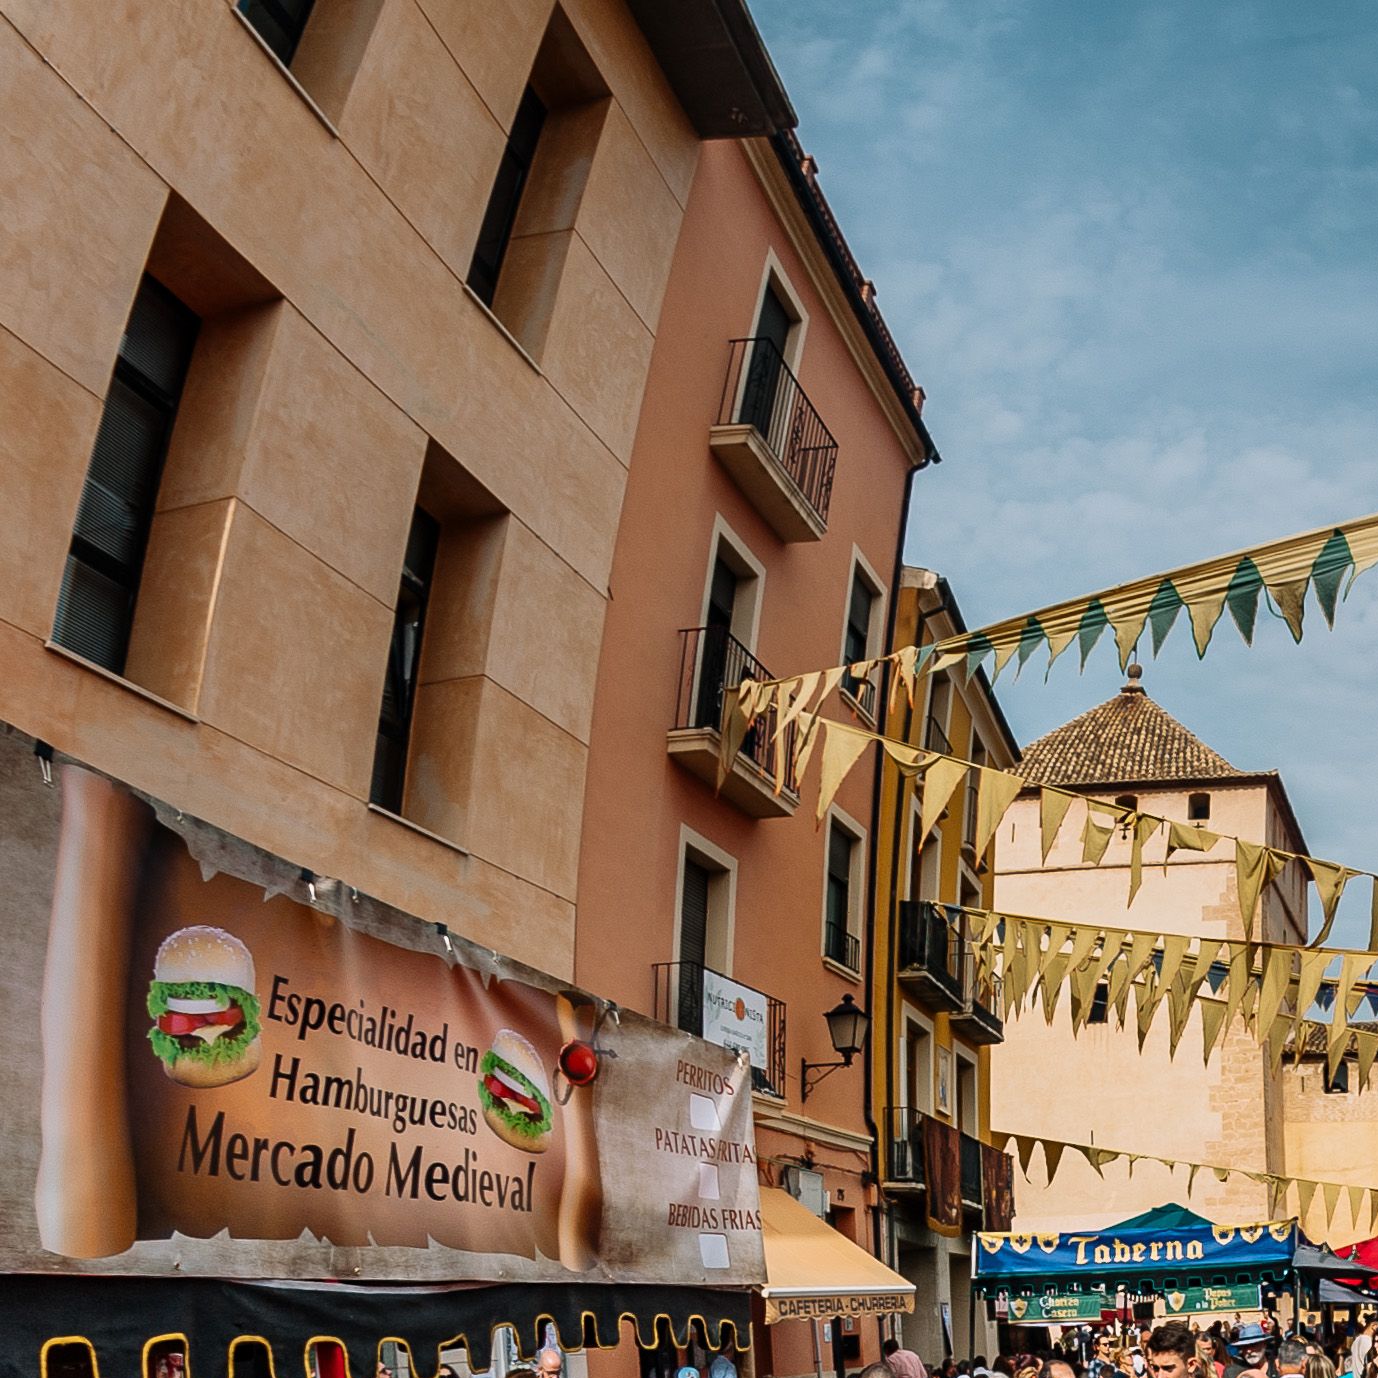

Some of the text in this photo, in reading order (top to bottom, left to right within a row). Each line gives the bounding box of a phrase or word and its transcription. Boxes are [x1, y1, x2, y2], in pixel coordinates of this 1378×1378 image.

[267, 974, 479, 1073] Especialidad en
[269, 1053, 478, 1135] Hamburguesas
[675, 1059, 735, 1095] PERRITOS
[177, 1104, 537, 1213] Mercado Medieval
[655, 1127, 716, 1159] PATATAS
[668, 1202, 762, 1231] BEBIDAS FRIAS
[1068, 1234, 1204, 1265] Taberna
[778, 1295, 907, 1317] CAFETERIA CHURRERIA
